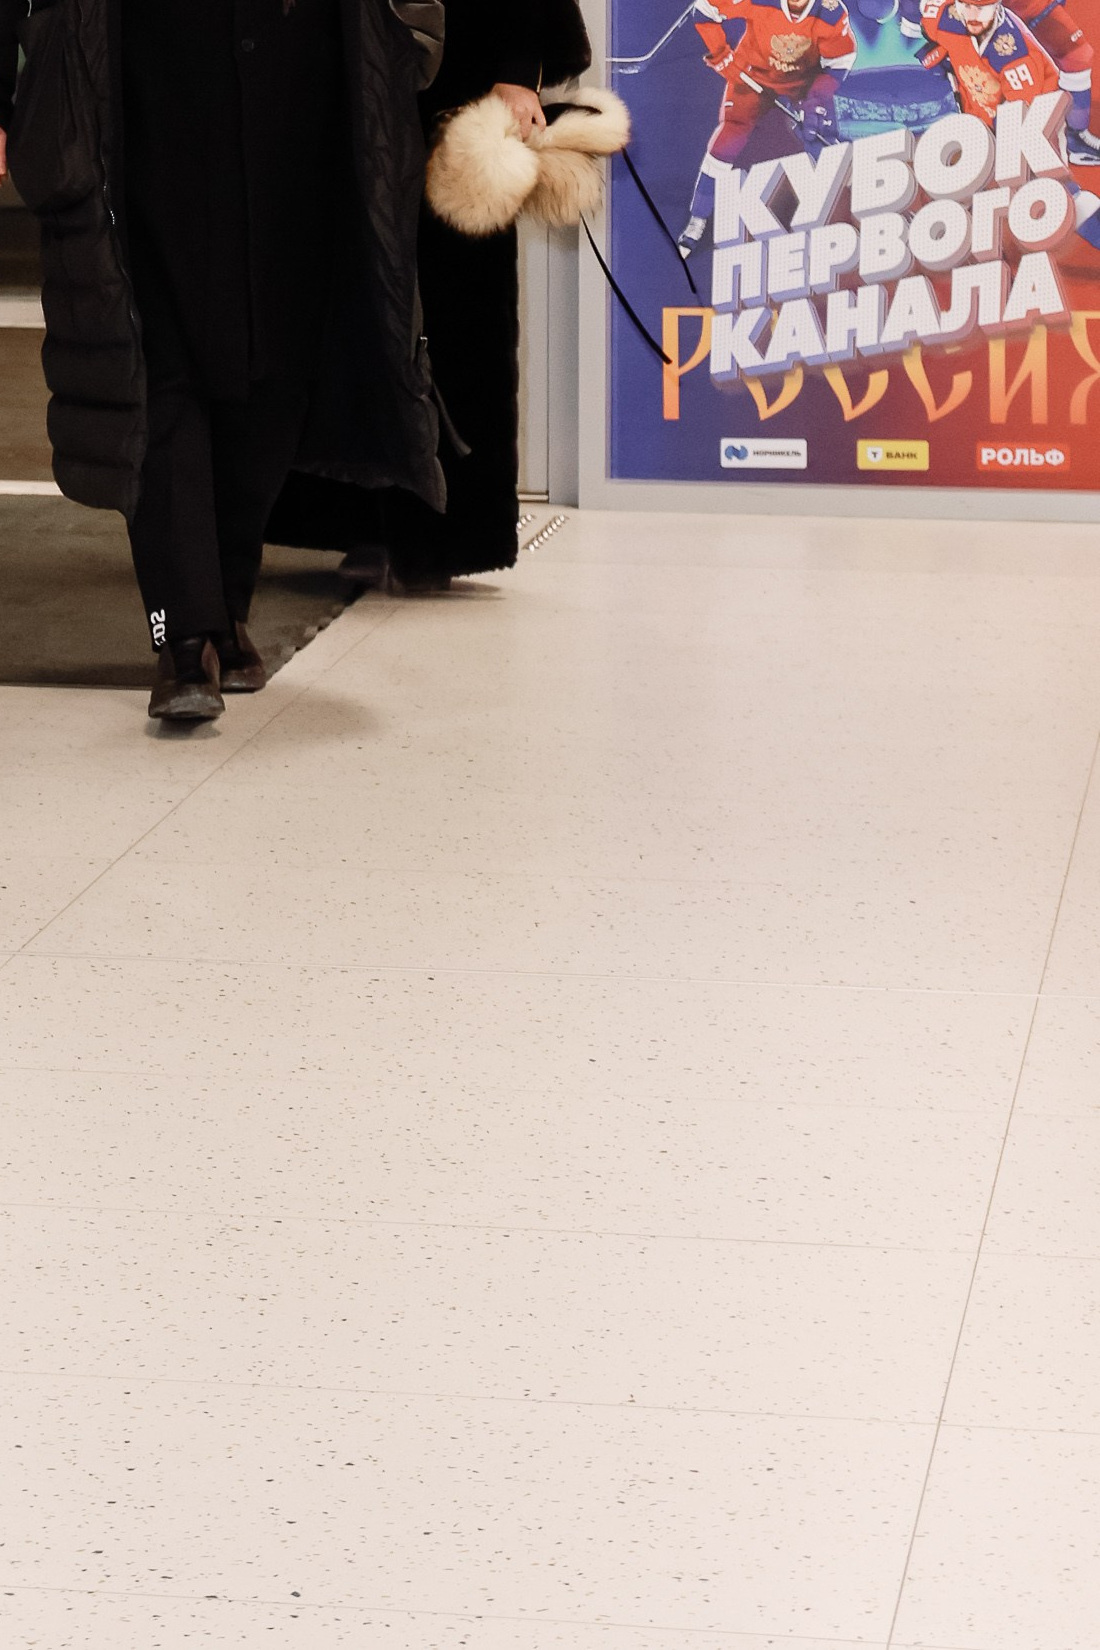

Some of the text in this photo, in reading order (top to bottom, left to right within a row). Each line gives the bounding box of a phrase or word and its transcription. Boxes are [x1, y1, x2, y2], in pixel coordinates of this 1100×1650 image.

[1003, 63, 1035, 91] 89
[712, 90, 1072, 244] КУБОК
[711, 177, 1075, 309] ПЕРВОГО
[710, 251, 1070, 381] КАНАЛА
[980, 447, 1065, 466] РОЛЬФ
